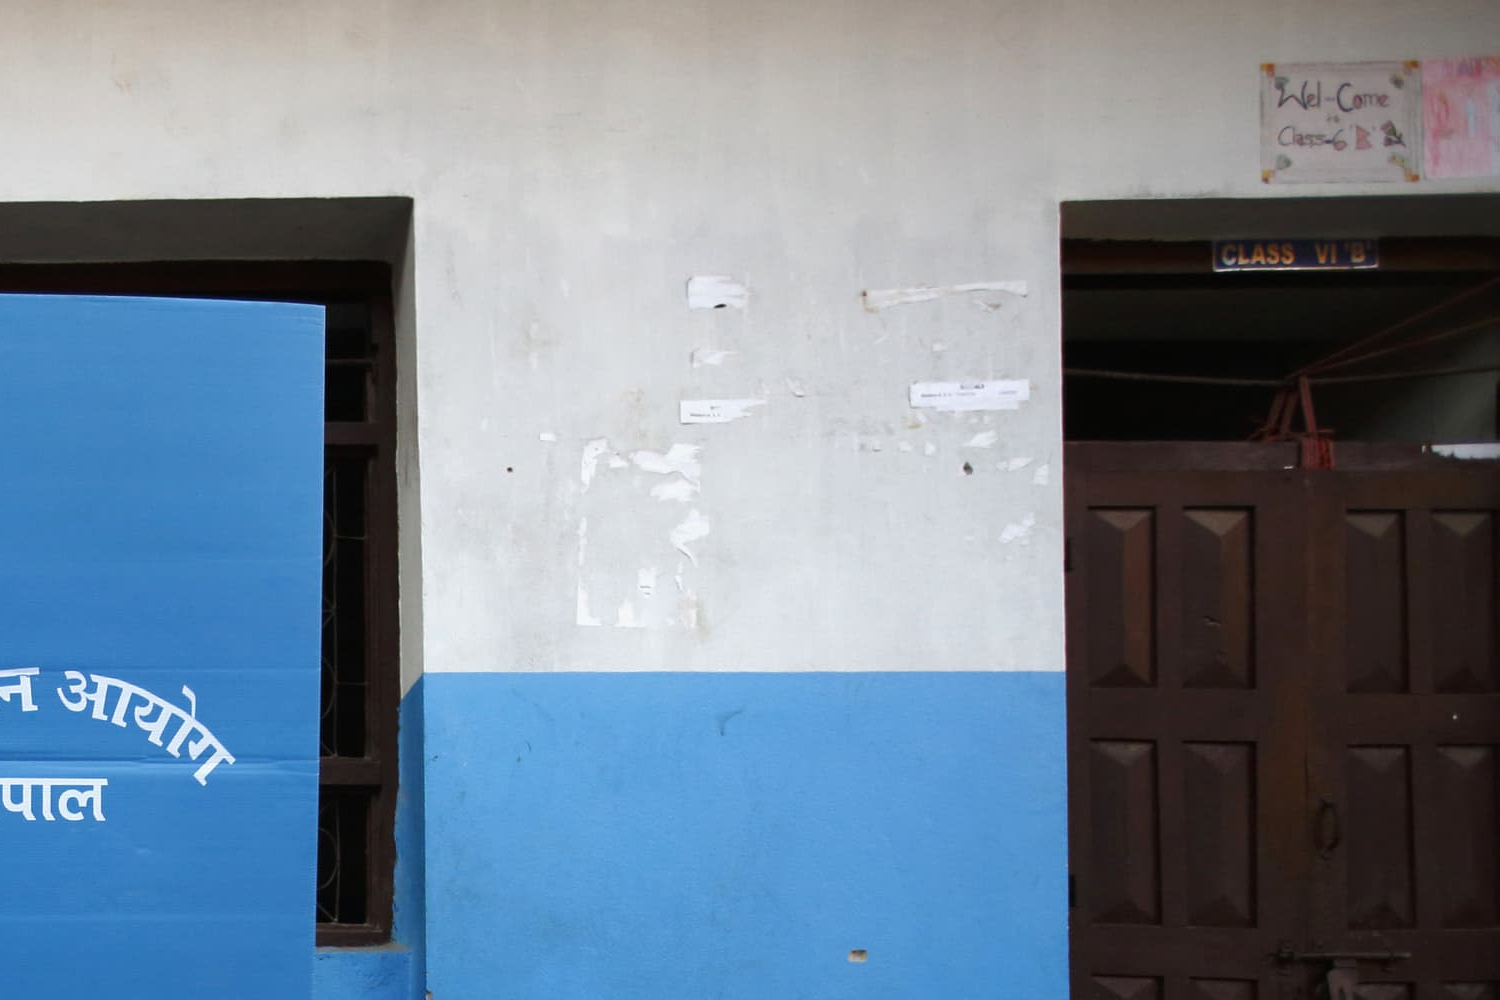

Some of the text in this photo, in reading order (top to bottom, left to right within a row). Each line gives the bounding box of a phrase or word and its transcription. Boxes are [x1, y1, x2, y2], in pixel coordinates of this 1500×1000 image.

[1220, 242, 1296, 266] CLASS
[1315, 241, 1337, 264] VI
[57, 670, 236, 786] आयोग
